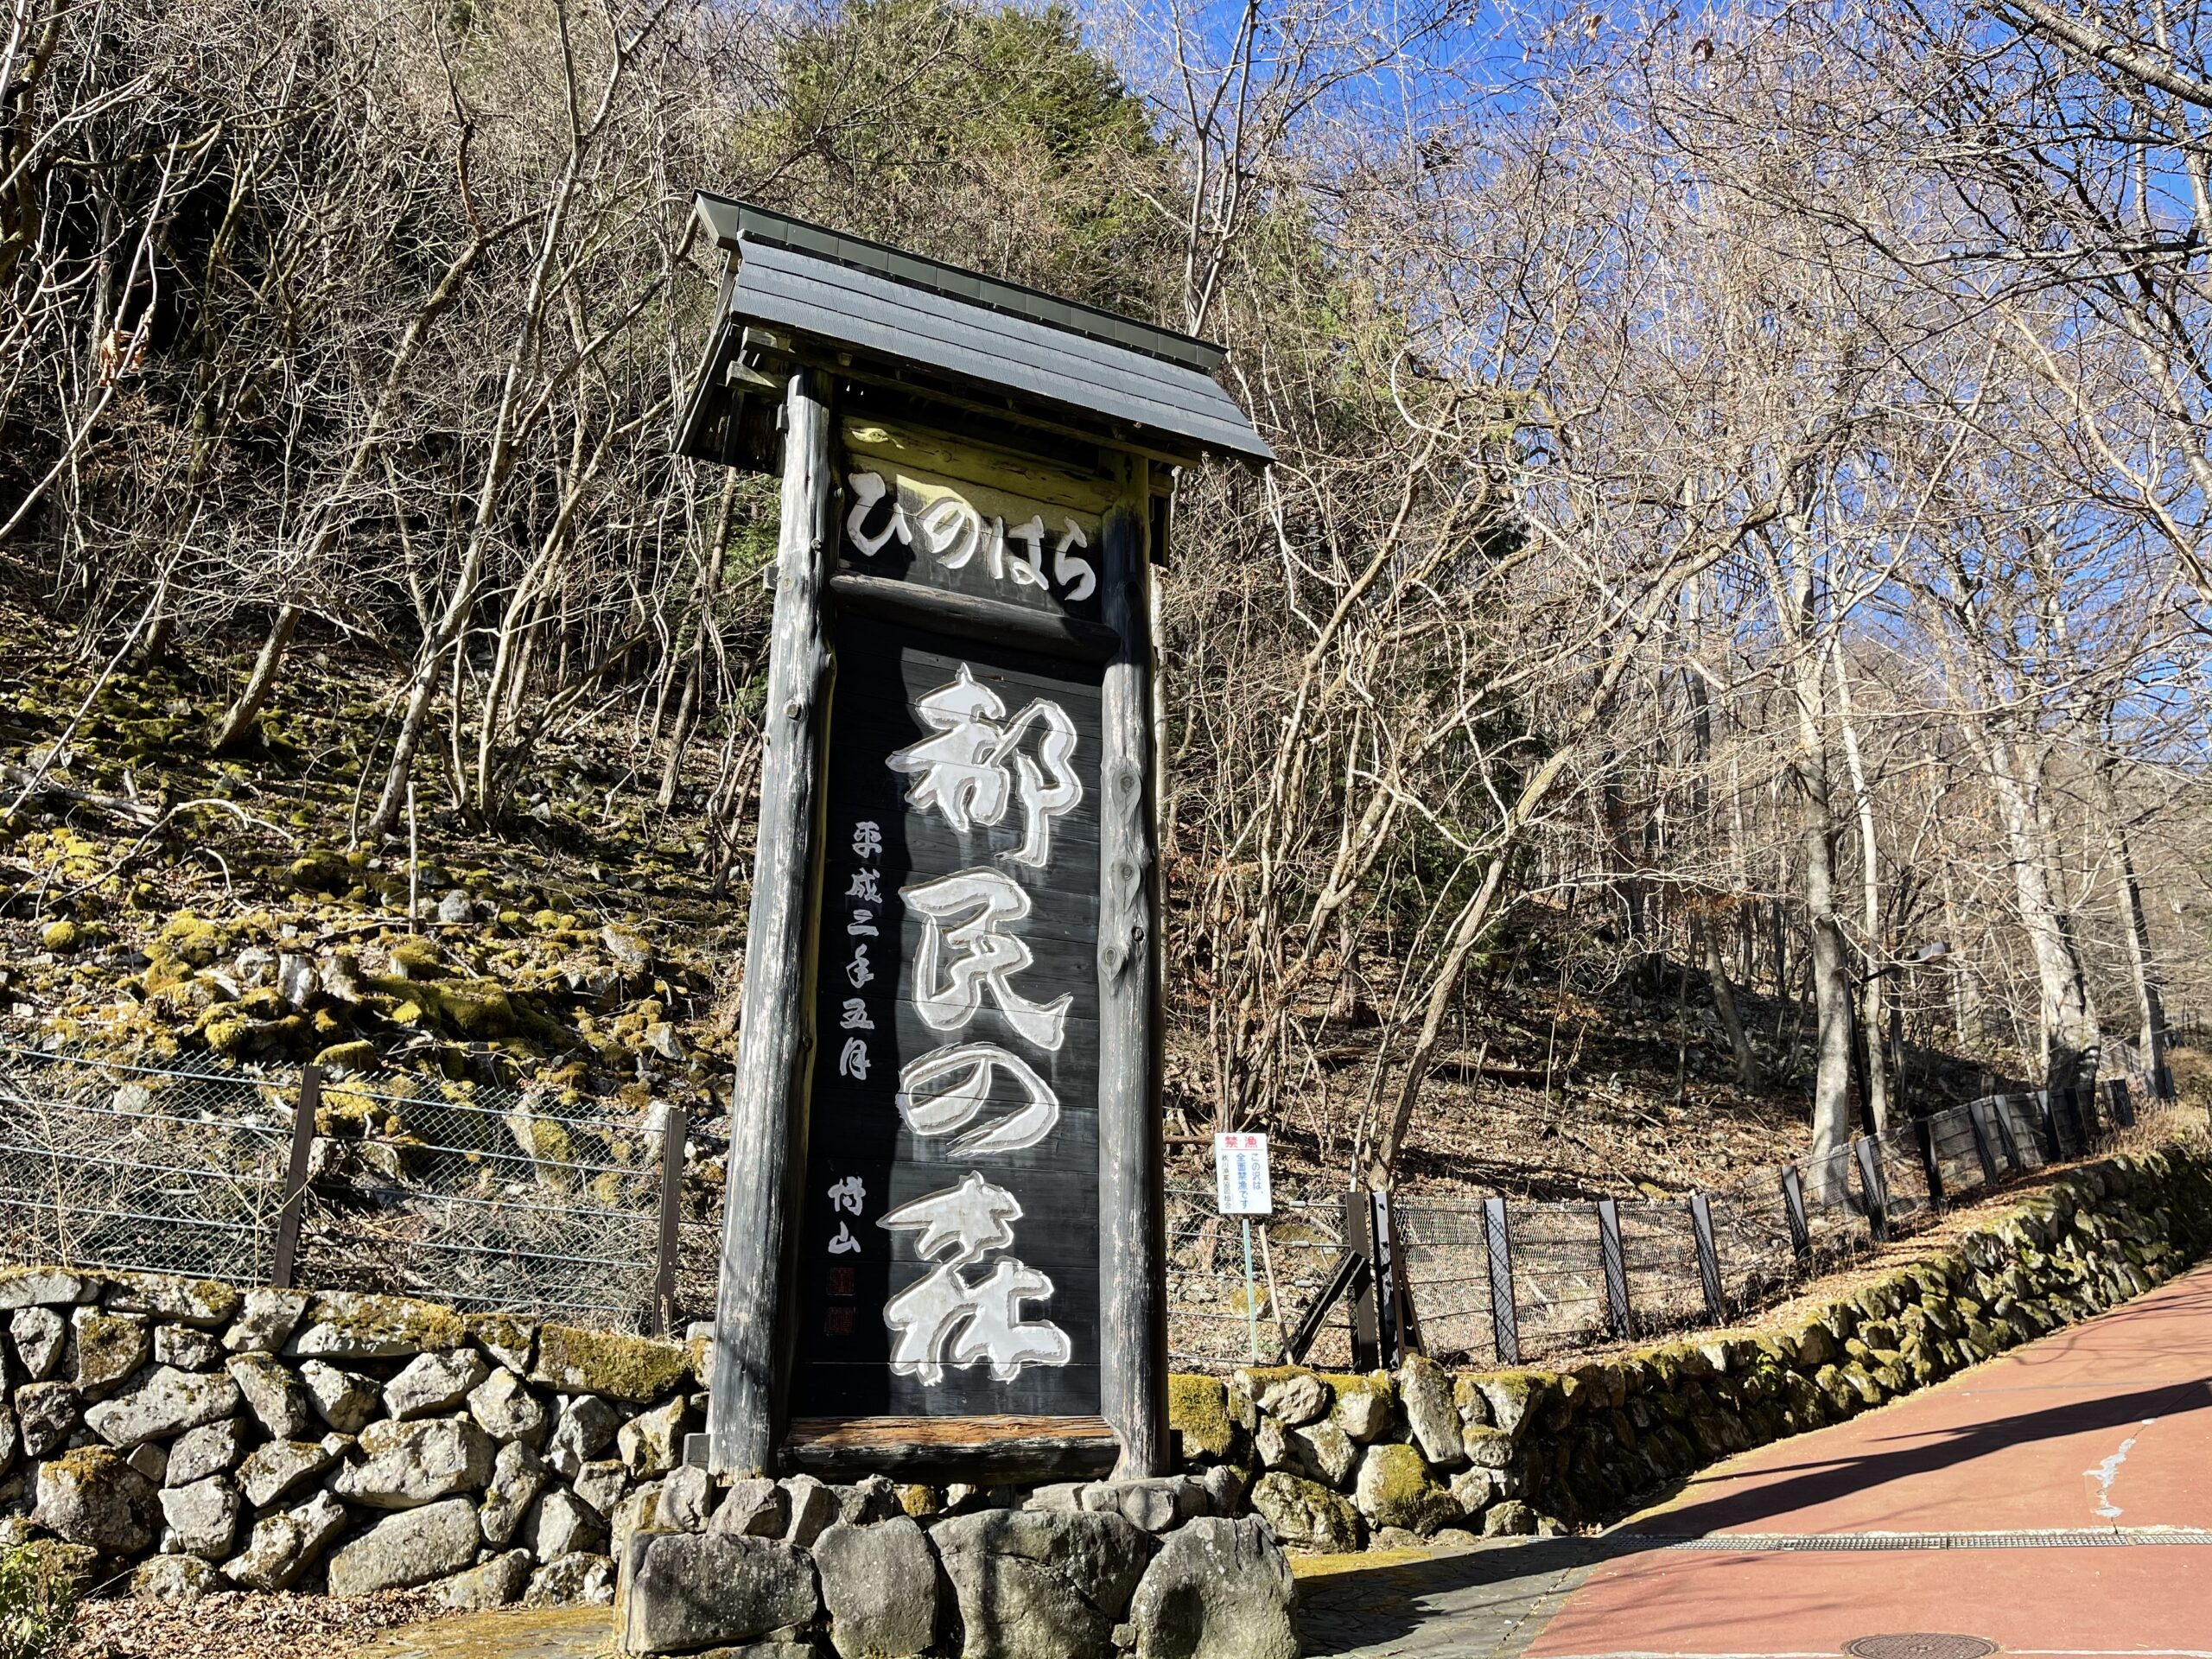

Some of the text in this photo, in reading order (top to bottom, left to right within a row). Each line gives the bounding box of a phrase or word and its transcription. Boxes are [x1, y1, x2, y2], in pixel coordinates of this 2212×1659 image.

[847, 472, 1096, 601] ひのはら
[840, 821, 883, 1080] 平成二年五月
[875, 662, 1084, 1386] 都民の森
[1224, 1135, 1258, 1148] 禁漁
[1236, 1153, 1249, 1210] 全面禁漁です
